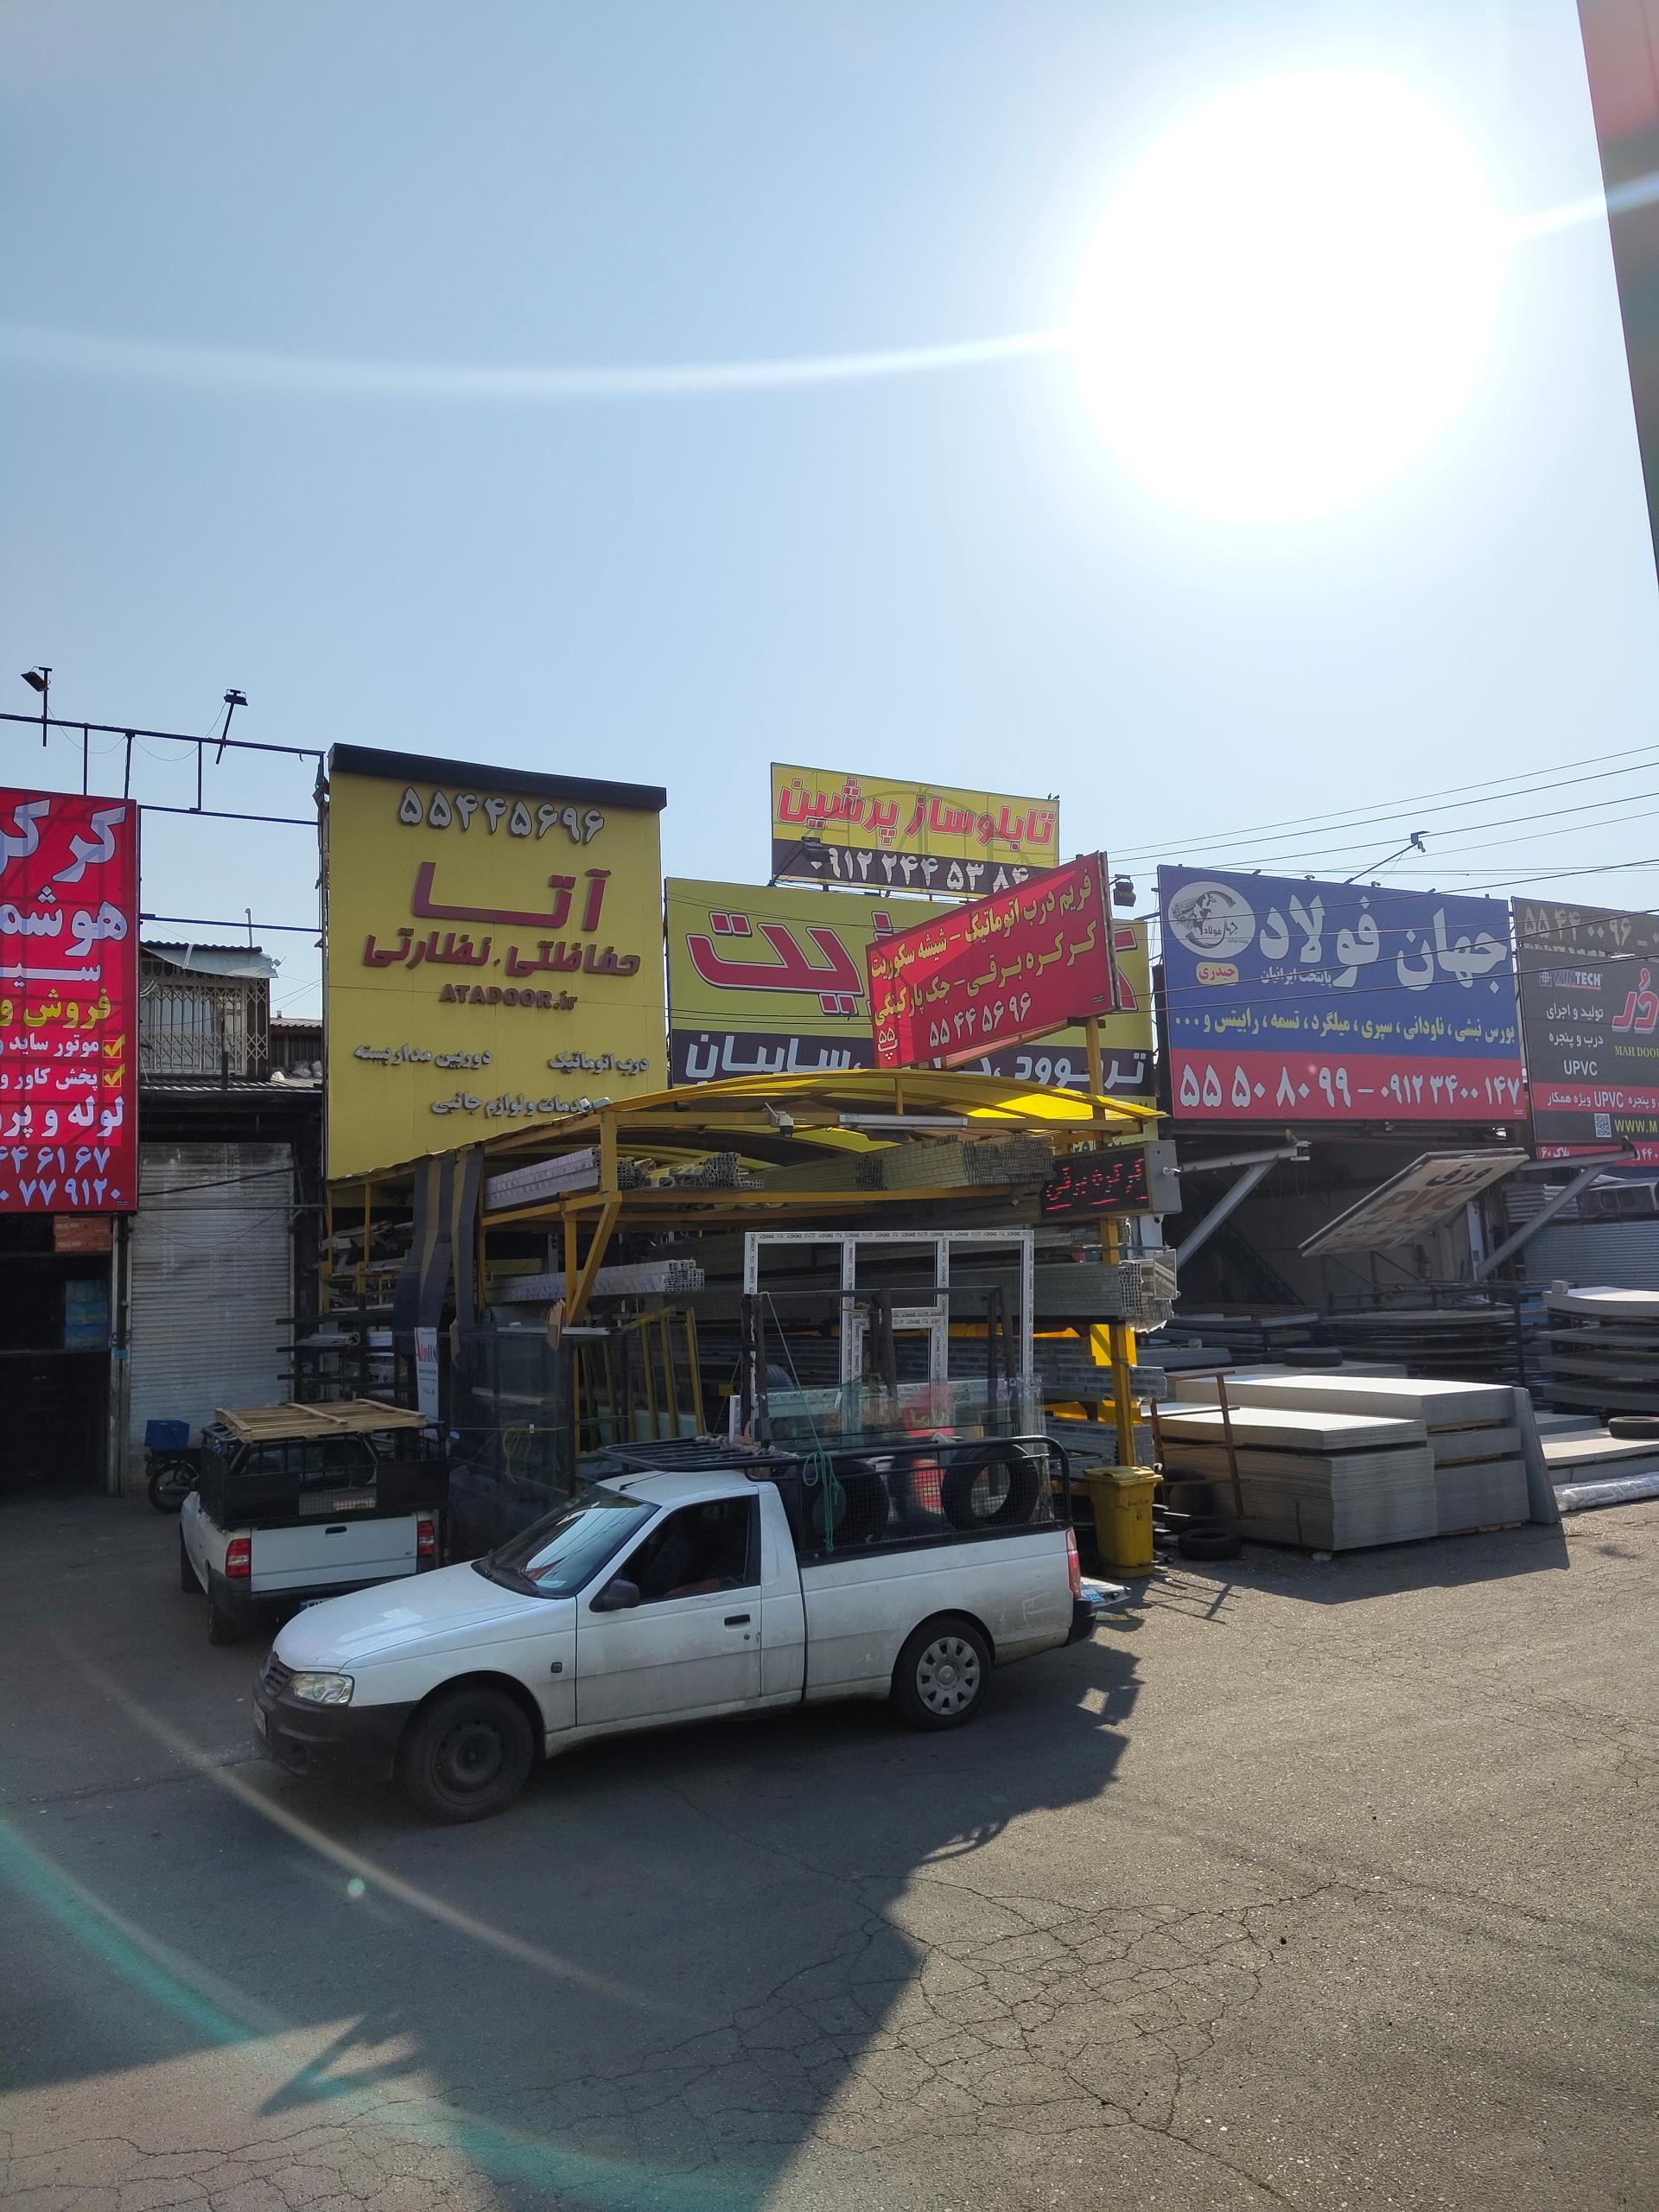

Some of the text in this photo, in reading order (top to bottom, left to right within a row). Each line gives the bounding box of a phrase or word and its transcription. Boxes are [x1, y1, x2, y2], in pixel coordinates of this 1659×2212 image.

[399, 787, 604, 845] ۵۵۴۴۵۶۹۶
[778, 778, 899, 846] پرشین
[881, 853, 938, 887] ۲۴۴
[946, 861, 984, 891] ۵۳
[411, 861, 613, 931] آتا
[1059, 868, 1092, 916] فریم
[964, 897, 1020, 944] اتوماتیک
[1023, 889, 1055, 926] درب
[1524, 906, 1550, 939] ۵۵
[1554, 909, 1581, 942] ۴۴
[361, 927, 493, 969] نظارتی
[918, 928, 948, 961] شیشه
[1259, 893, 1509, 995] جهان فولاد
[871, 943, 915, 980] سکوریت
[966, 953, 1023, 998] برقی
[925, 976, 950, 1004] جک
[1552, 969, 1602, 987] WINTECH
[22, 988, 112, 1030] فروش
[438, 983, 579, 1011] ATADOOR.ir
[929, 991, 1033, 1049] ۵۵ ۴۴ ۵۶ ۹۶
[1580, 1006, 1605, 1021] تولید
[9, 1032, 48, 1055] ساید
[1455, 1018, 1482, 1042] نبشی
[1484, 1025, 1515, 1044] بورس
[54, 1033, 99, 1058] موتور
[353, 1043, 493, 1070] دوربین مدار بسته
[1614, 1046, 1635, 1057] MAH
[549, 1050, 651, 1077] درب اتوماتیک
[1563, 1059, 1598, 1077] UPVC
[14, 1066, 51, 1090] کاور
[55, 1068, 99, 1090] پخش
[1179, 1063, 1224, 1108] ۵۵
[1231, 1064, 1266, 1108] ۵۰
[1275, 1065, 1310, 1108] ۸۰
[1319, 1066, 1352, 1109] ۹۹
[1380, 1073, 1423, 1105] ۰۹۱۲
[1429, 1074, 1479, 1106] ۳۴۰۰
[1484, 1075, 1521, 1107] ۱۴۷
[431, 1090, 482, 1114] جانبی
[539, 1093, 583, 1114] دمات
[1593, 1090, 1624, 1109] UPVC
[0, 1095, 125, 1139] لوله و پر
[1614, 1119, 1659, 1134] WWW.M
[19, 1179, 57, 1207] ۷۷
